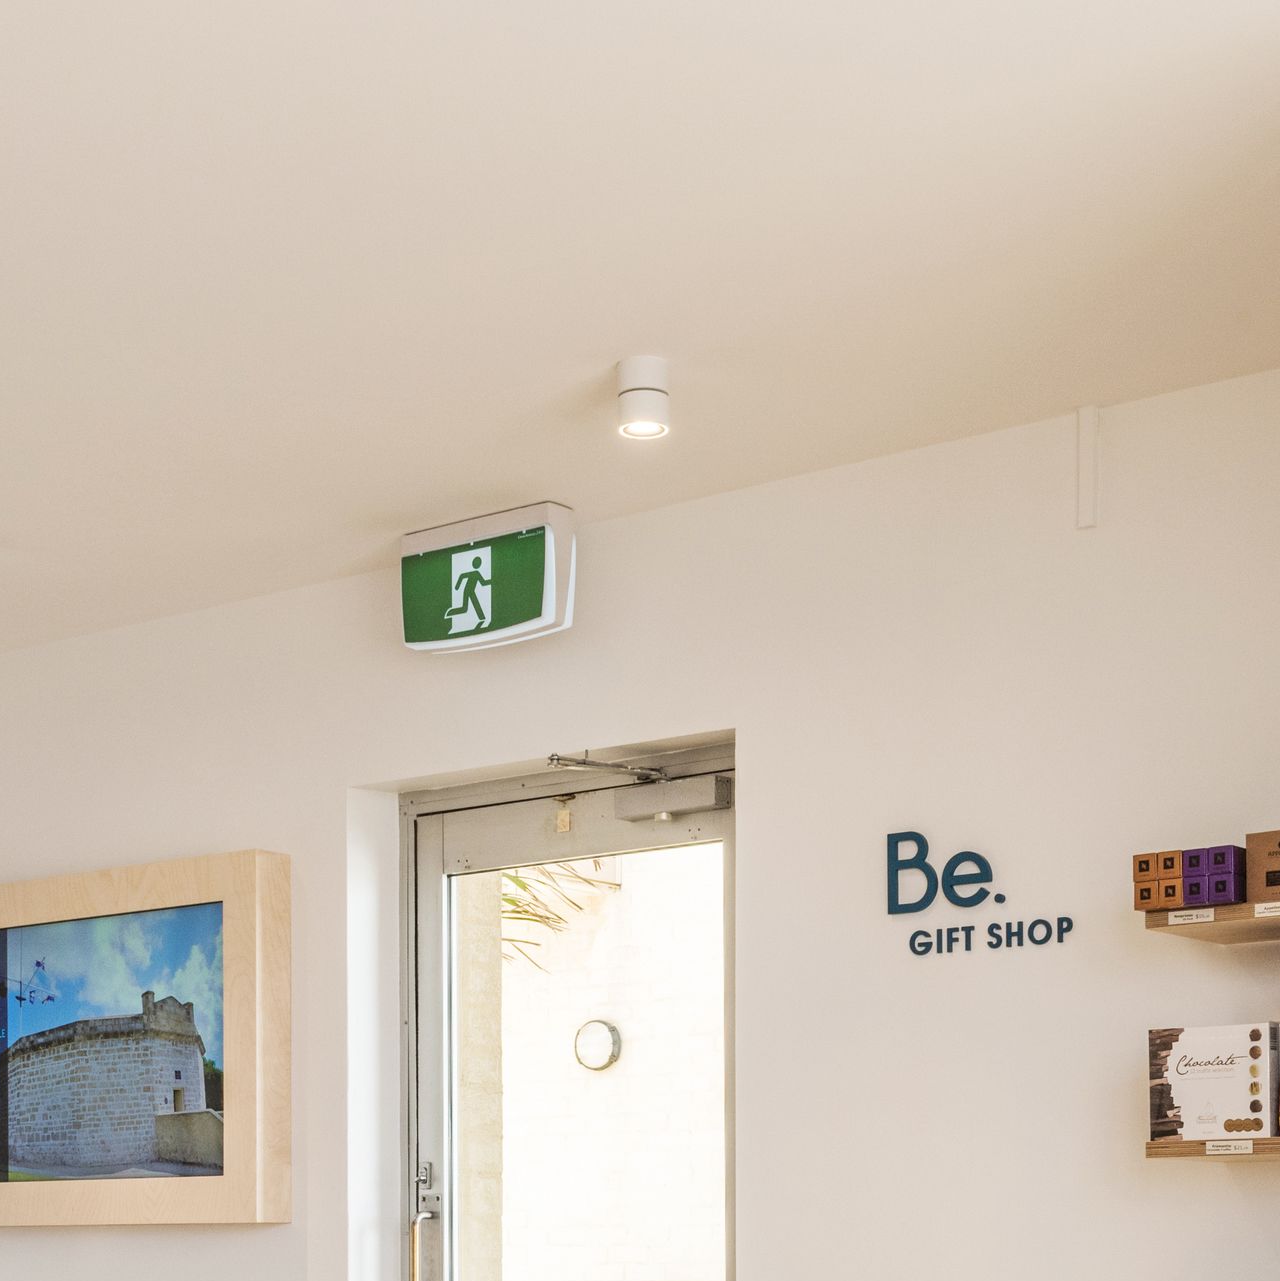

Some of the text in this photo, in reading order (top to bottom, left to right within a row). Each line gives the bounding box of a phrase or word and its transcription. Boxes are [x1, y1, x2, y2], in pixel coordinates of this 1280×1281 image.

[887, 831, 1006, 915] Be.
[909, 917, 1074, 955] GIFT SHOP
[1176, 1053, 1248, 1075] Chocolate
